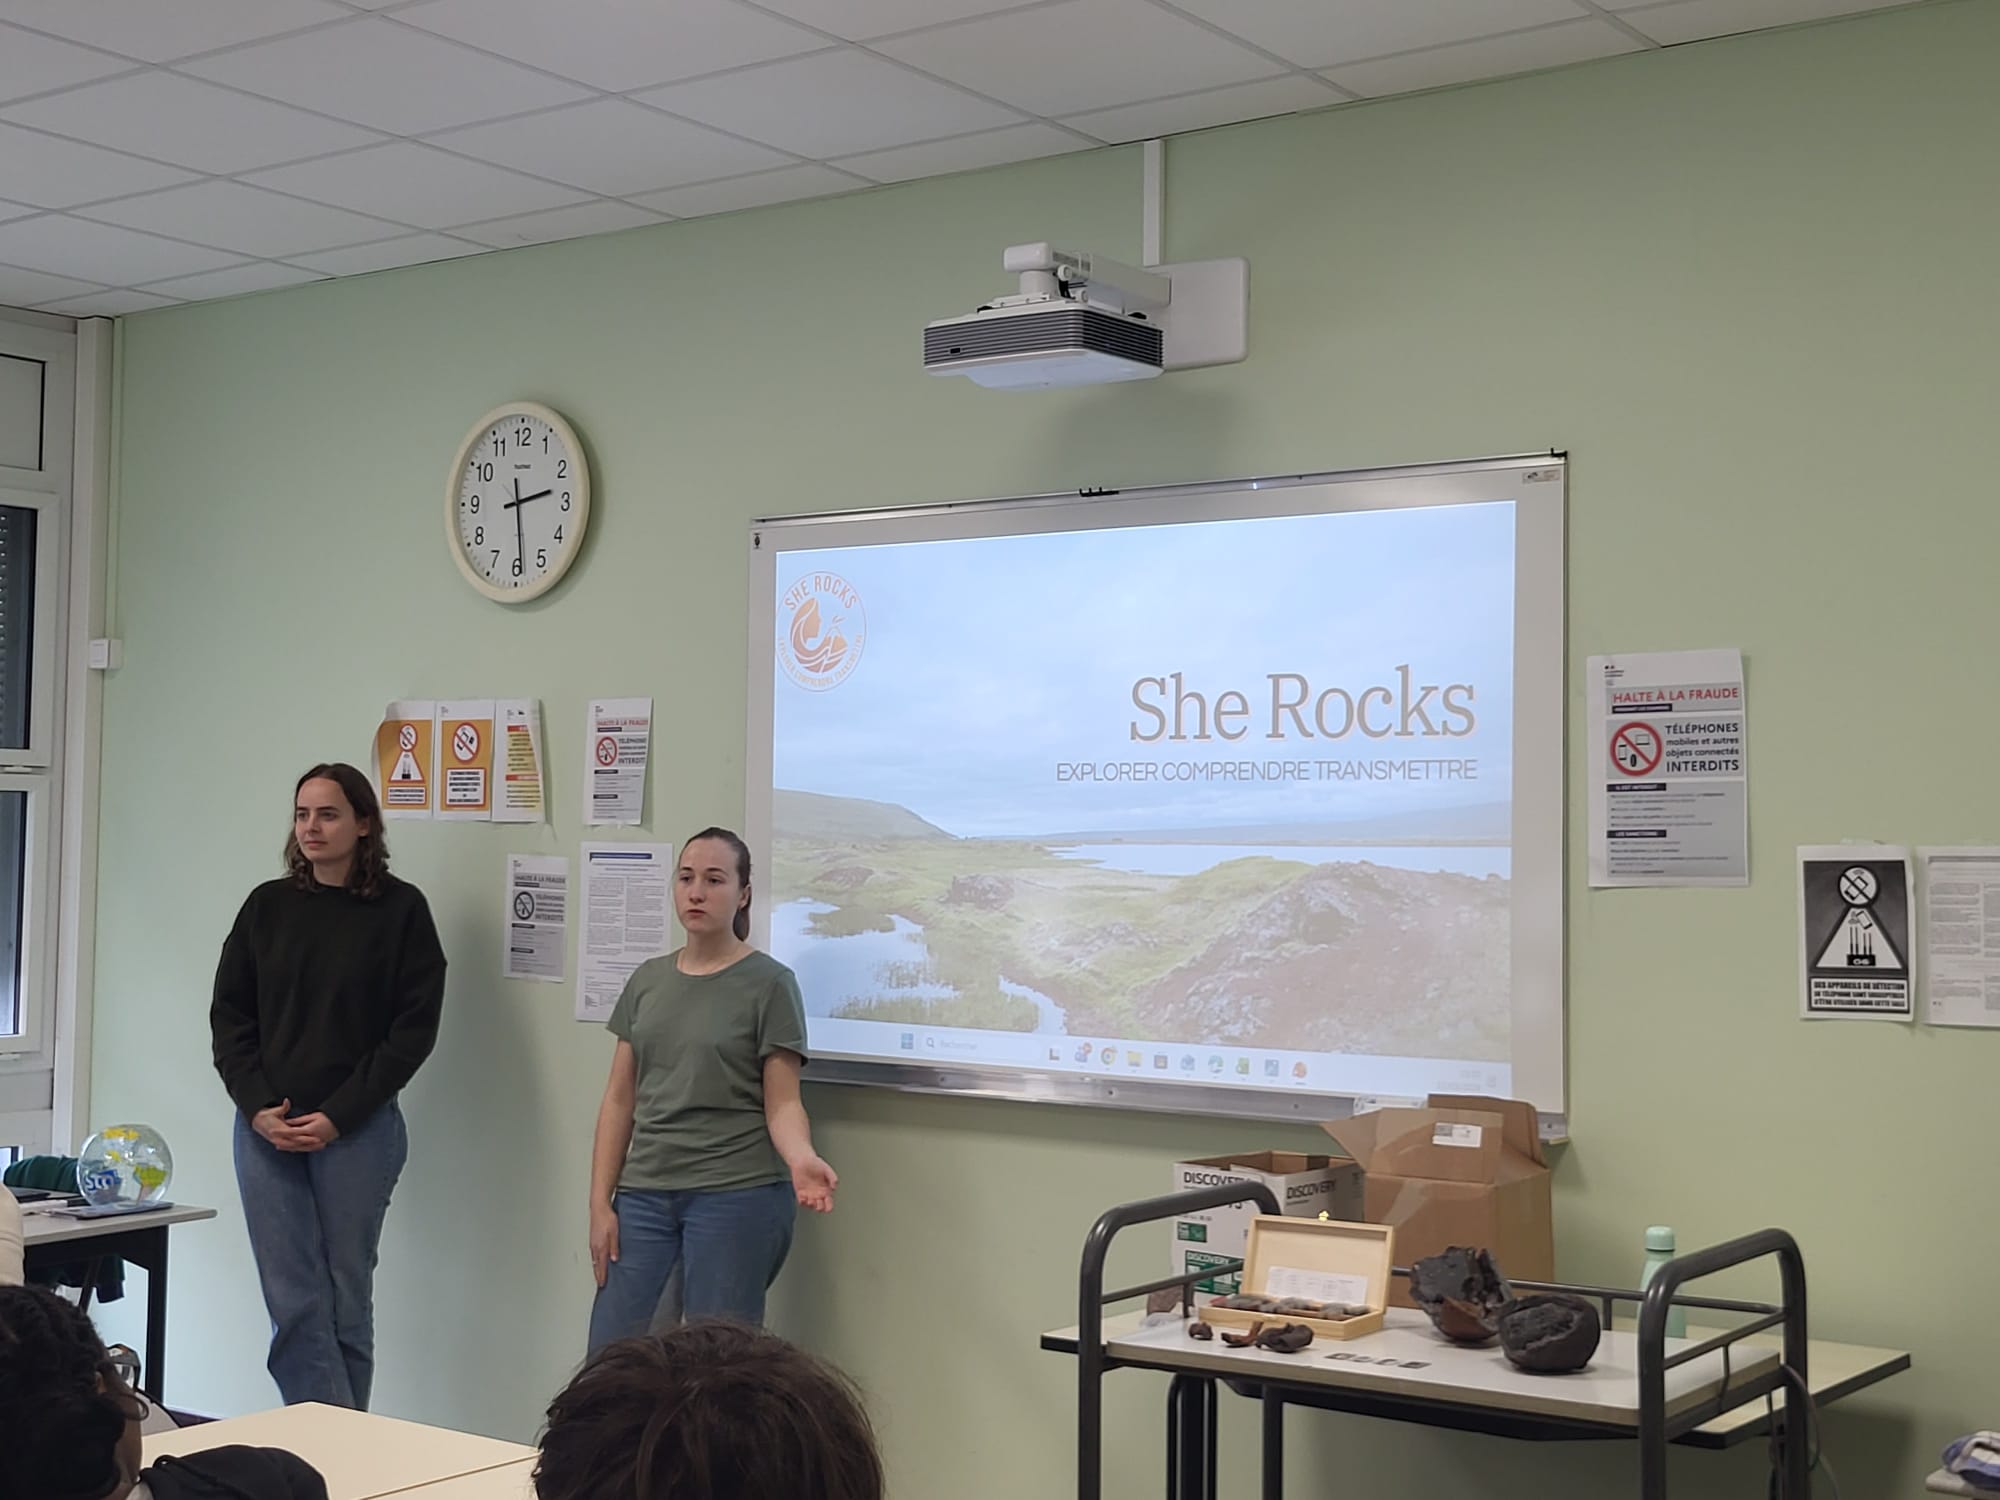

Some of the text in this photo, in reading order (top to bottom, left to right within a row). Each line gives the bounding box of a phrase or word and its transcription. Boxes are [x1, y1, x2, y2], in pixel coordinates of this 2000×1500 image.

[514, 427, 532, 447] 12
[542, 435, 549, 455] 1
[493, 438, 506, 457] 11
[476, 462, 494, 483] 10
[557, 459, 567, 479] 2
[470, 495, 480, 514] 9
[560, 492, 571, 512] 3
[474, 526, 484, 546] 8
[554, 524, 564, 544] 4
[491, 550, 500, 569] 7
[511, 558, 522, 577] 6
[536, 549, 546, 568] 5
[784, 575, 857, 611] SHE ROCKS
[1130, 664, 1476, 743] She Rocks
[1613, 691, 1653, 703] HALTE
[1669, 690, 1685, 701] LA
[1688, 687, 1739, 700] FRAUDE
[1664, 722, 1739, 735] TÉLÉPHONES
[1666, 737, 1739, 747] mobiles et autres
[1665, 747, 1739, 759] objets connectés
[1056, 759, 1478, 782] EXPLORER COMPRENDRE TRANSMETTRE
[1666, 759, 1739, 773] INTERDITS
[1184, 1171, 1251, 1186] DISCOVE
[1286, 1178, 1337, 1200] DISCOVERY
